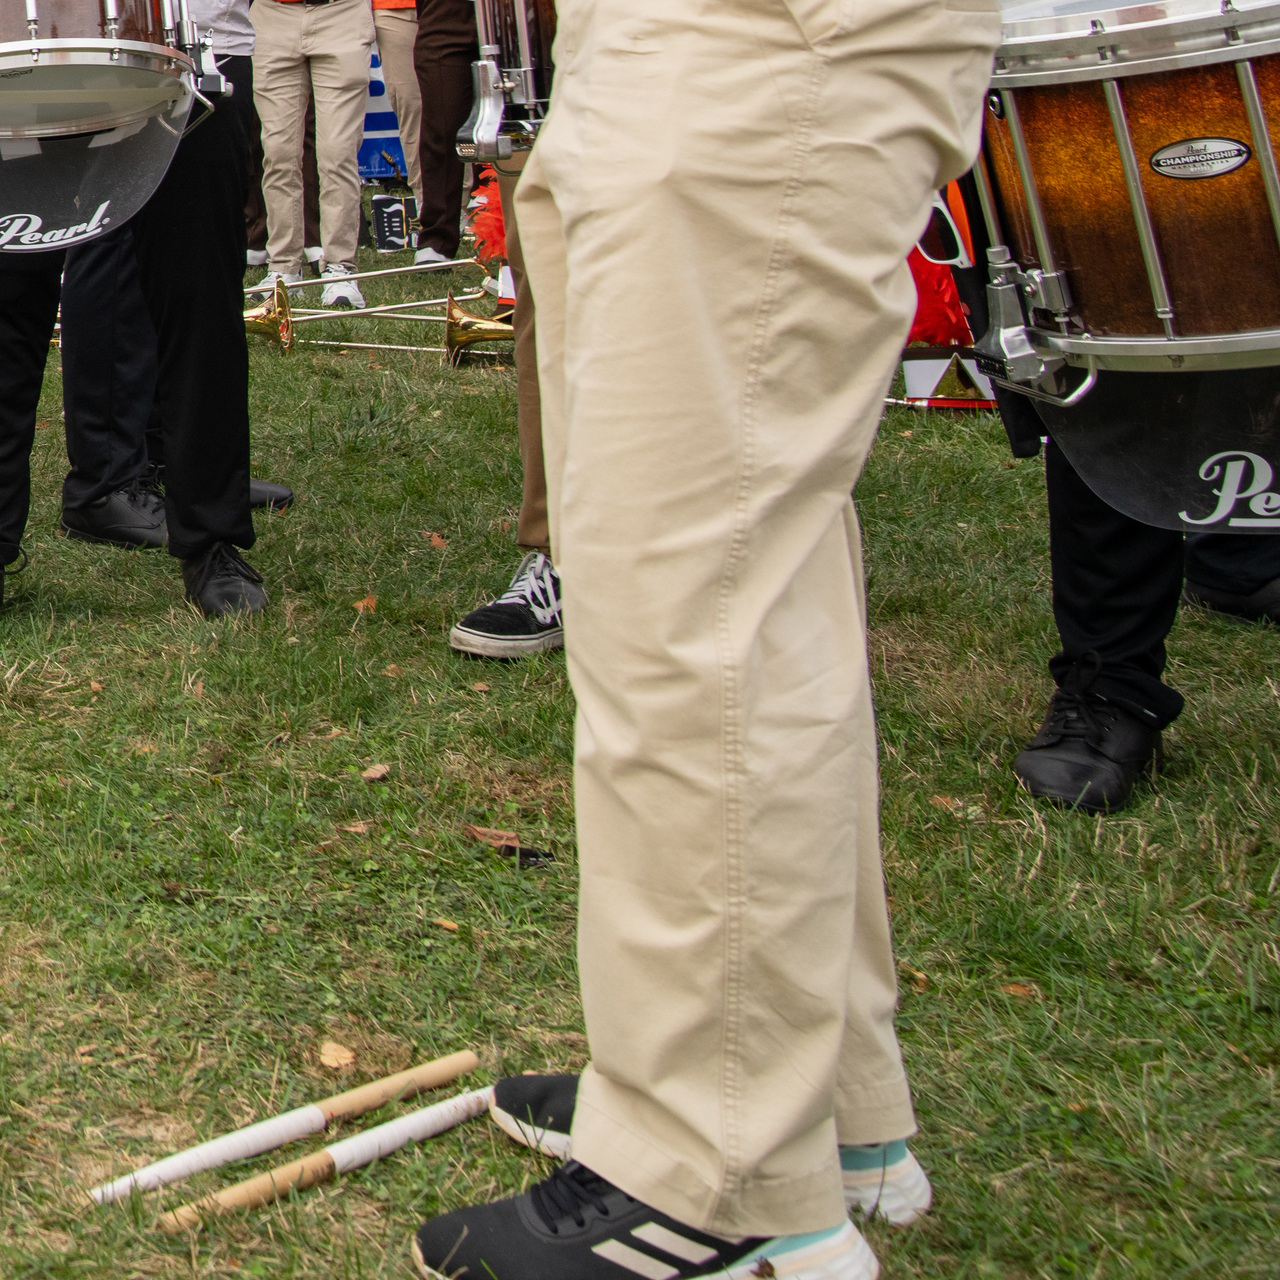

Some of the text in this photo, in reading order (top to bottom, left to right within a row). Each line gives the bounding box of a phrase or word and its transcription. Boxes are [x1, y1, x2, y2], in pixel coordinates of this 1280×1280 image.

[1187, 144, 1208, 154] Pearl
[1160, 150, 1239, 167] CHAMPIONSHIP
[1171, 162, 1197, 170] MAPLE
